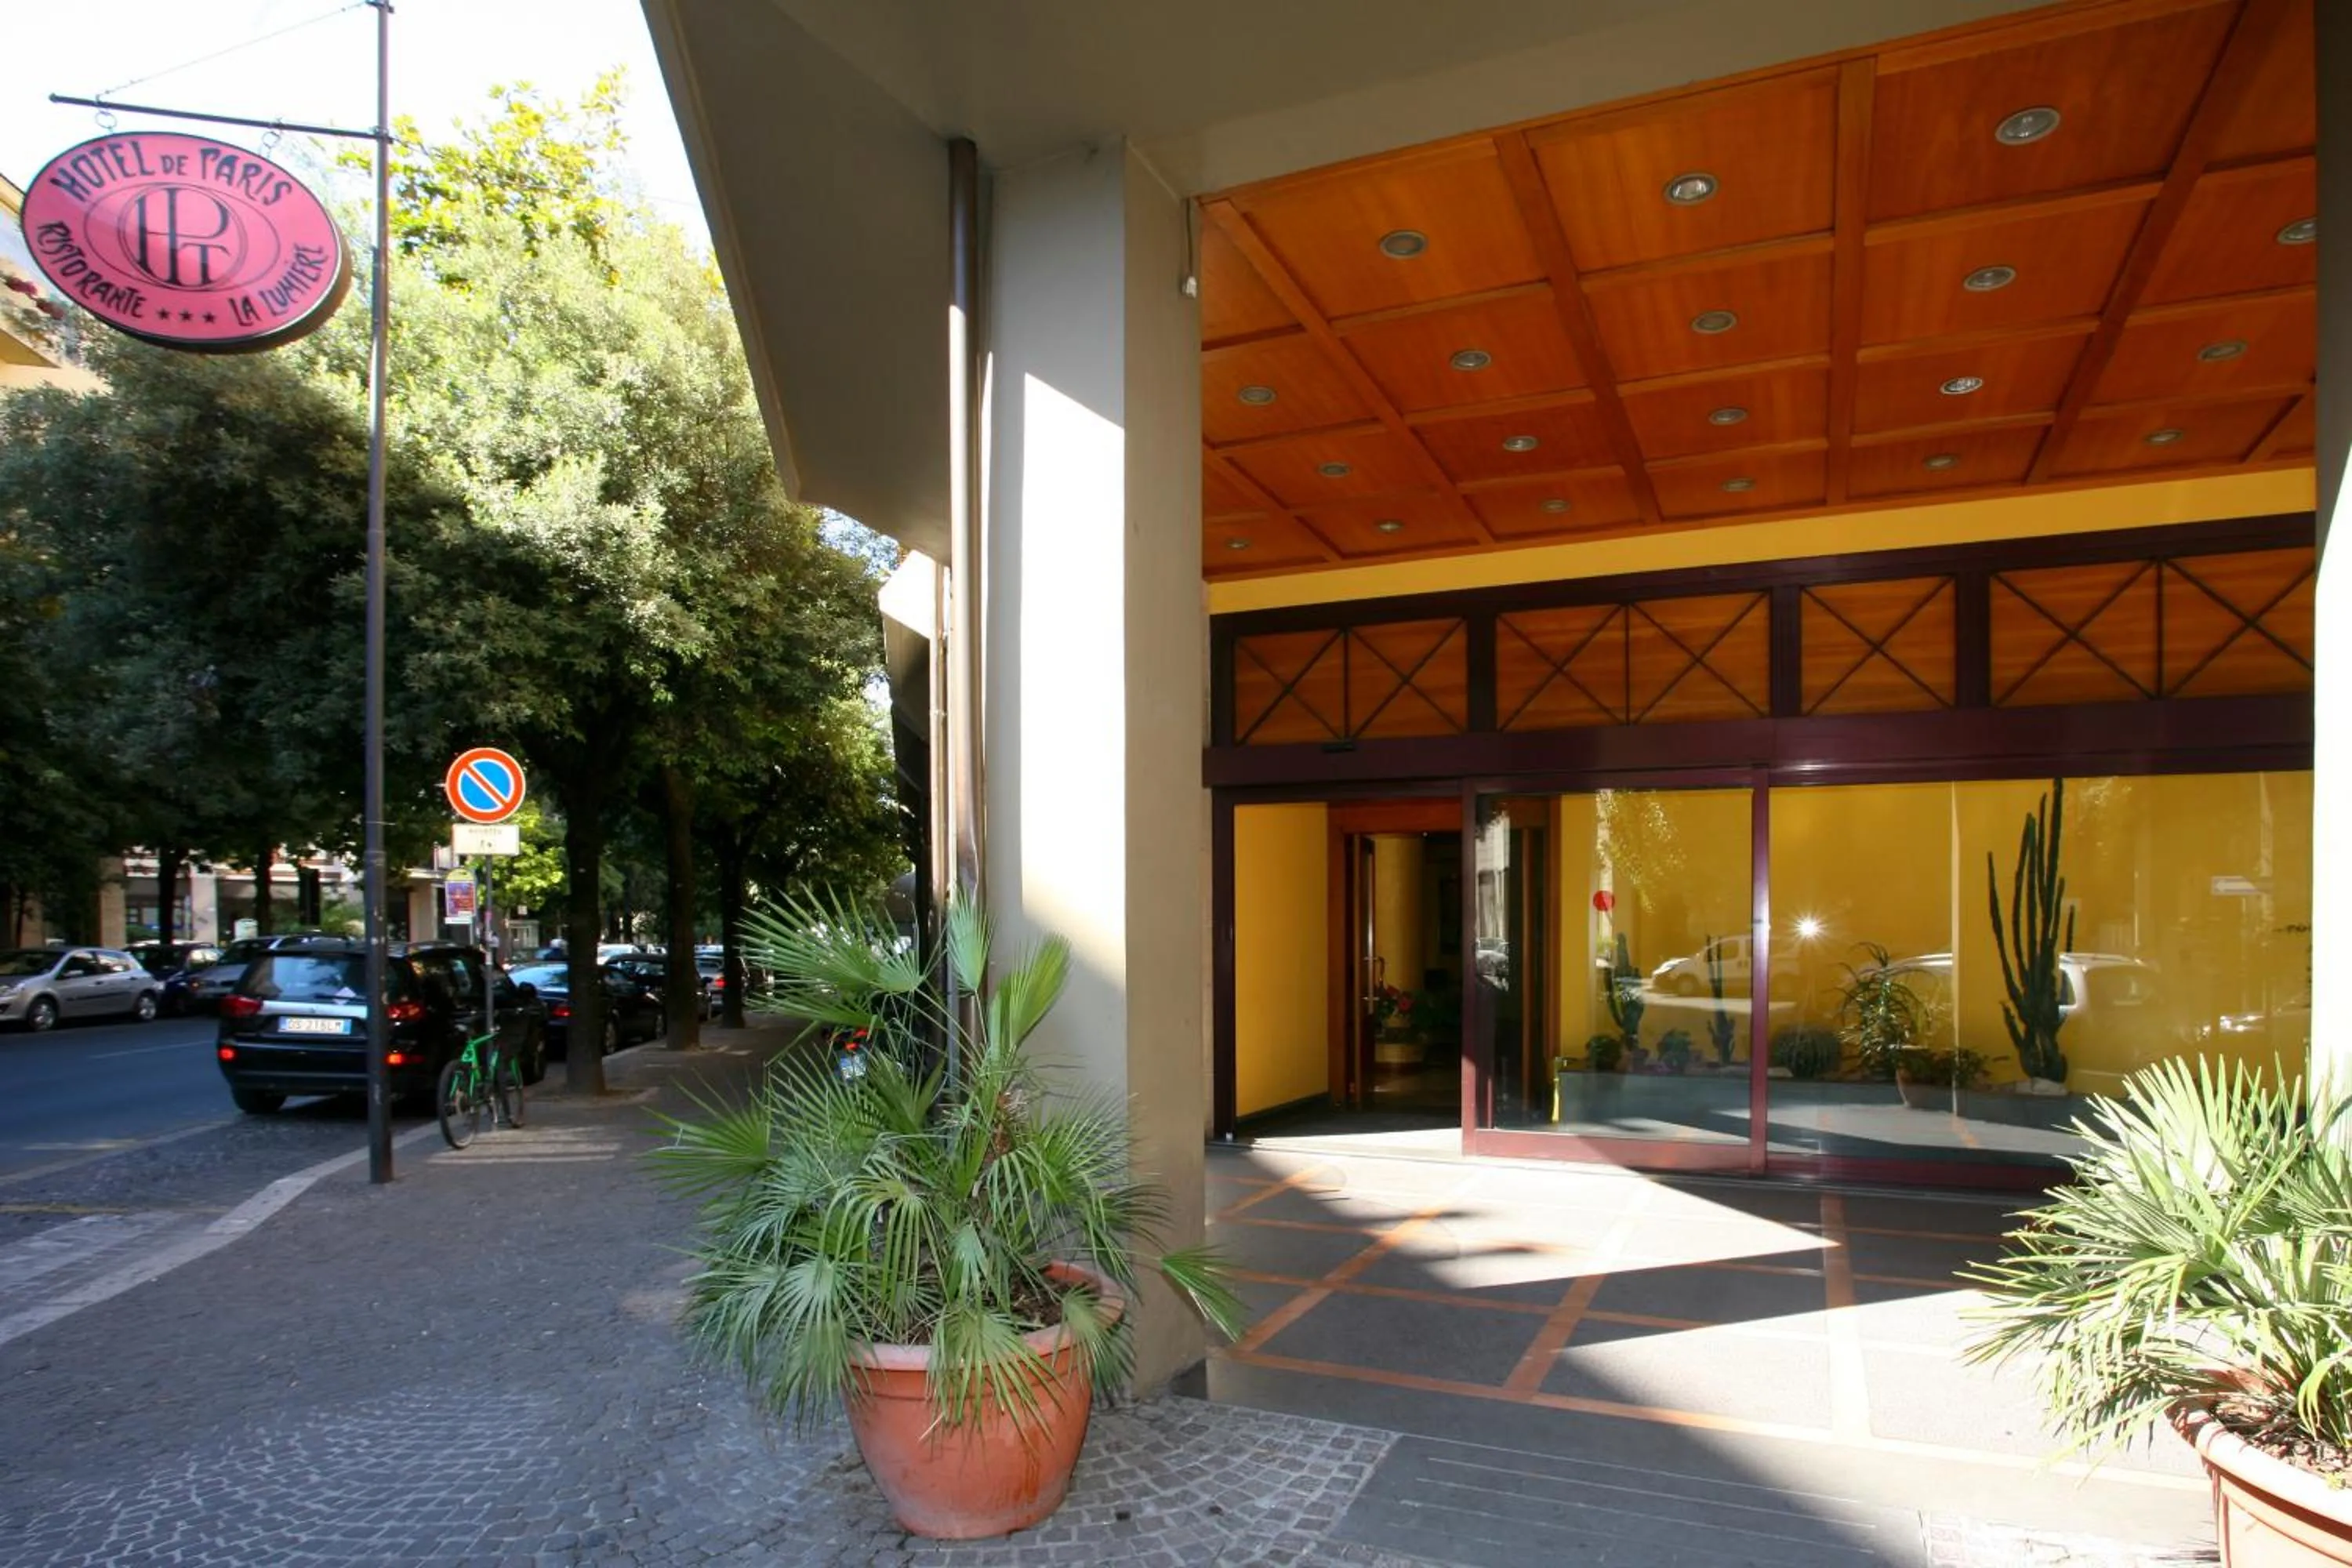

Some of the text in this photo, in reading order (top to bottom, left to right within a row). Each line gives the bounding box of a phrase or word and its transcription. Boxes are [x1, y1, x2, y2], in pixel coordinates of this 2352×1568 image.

[51, 141, 292, 206] HOTEL DE PARIS
[38, 221, 147, 318] RISTORANTE
[228, 296, 260, 327] LA
